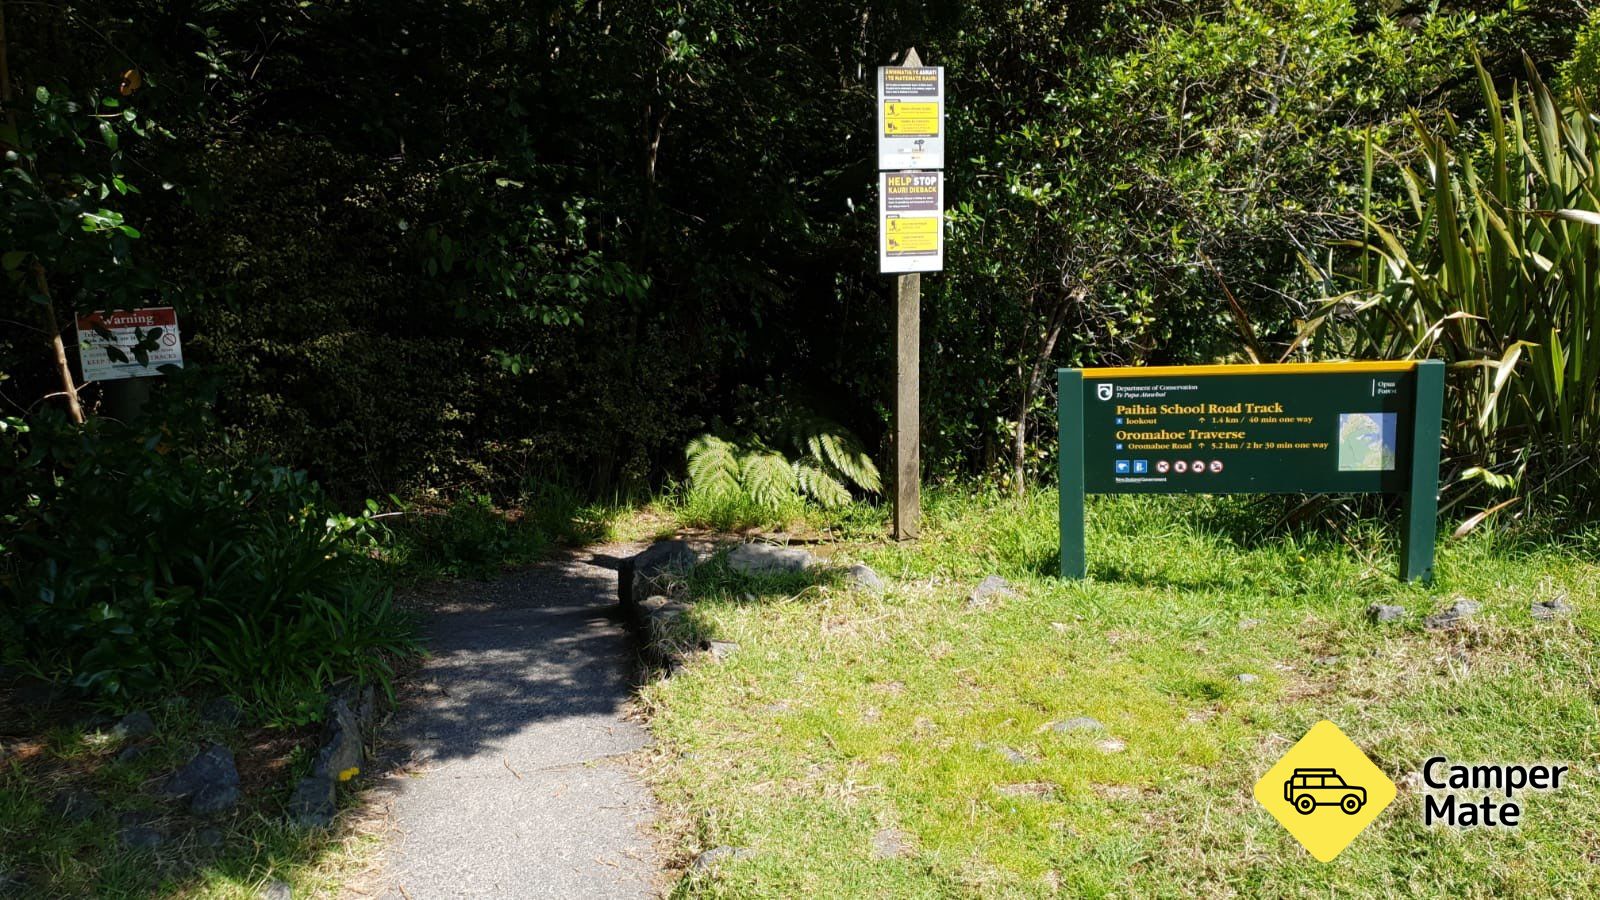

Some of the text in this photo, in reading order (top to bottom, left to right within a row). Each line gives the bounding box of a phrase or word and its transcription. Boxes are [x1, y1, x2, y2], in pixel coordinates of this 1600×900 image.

[888, 176, 937, 186] HELP STOP
[100, 314, 154, 325] Warning
[1116, 402, 1284, 415] Paihia School Road Track
[1116, 429, 1246, 440] Oromahoe Traverse
